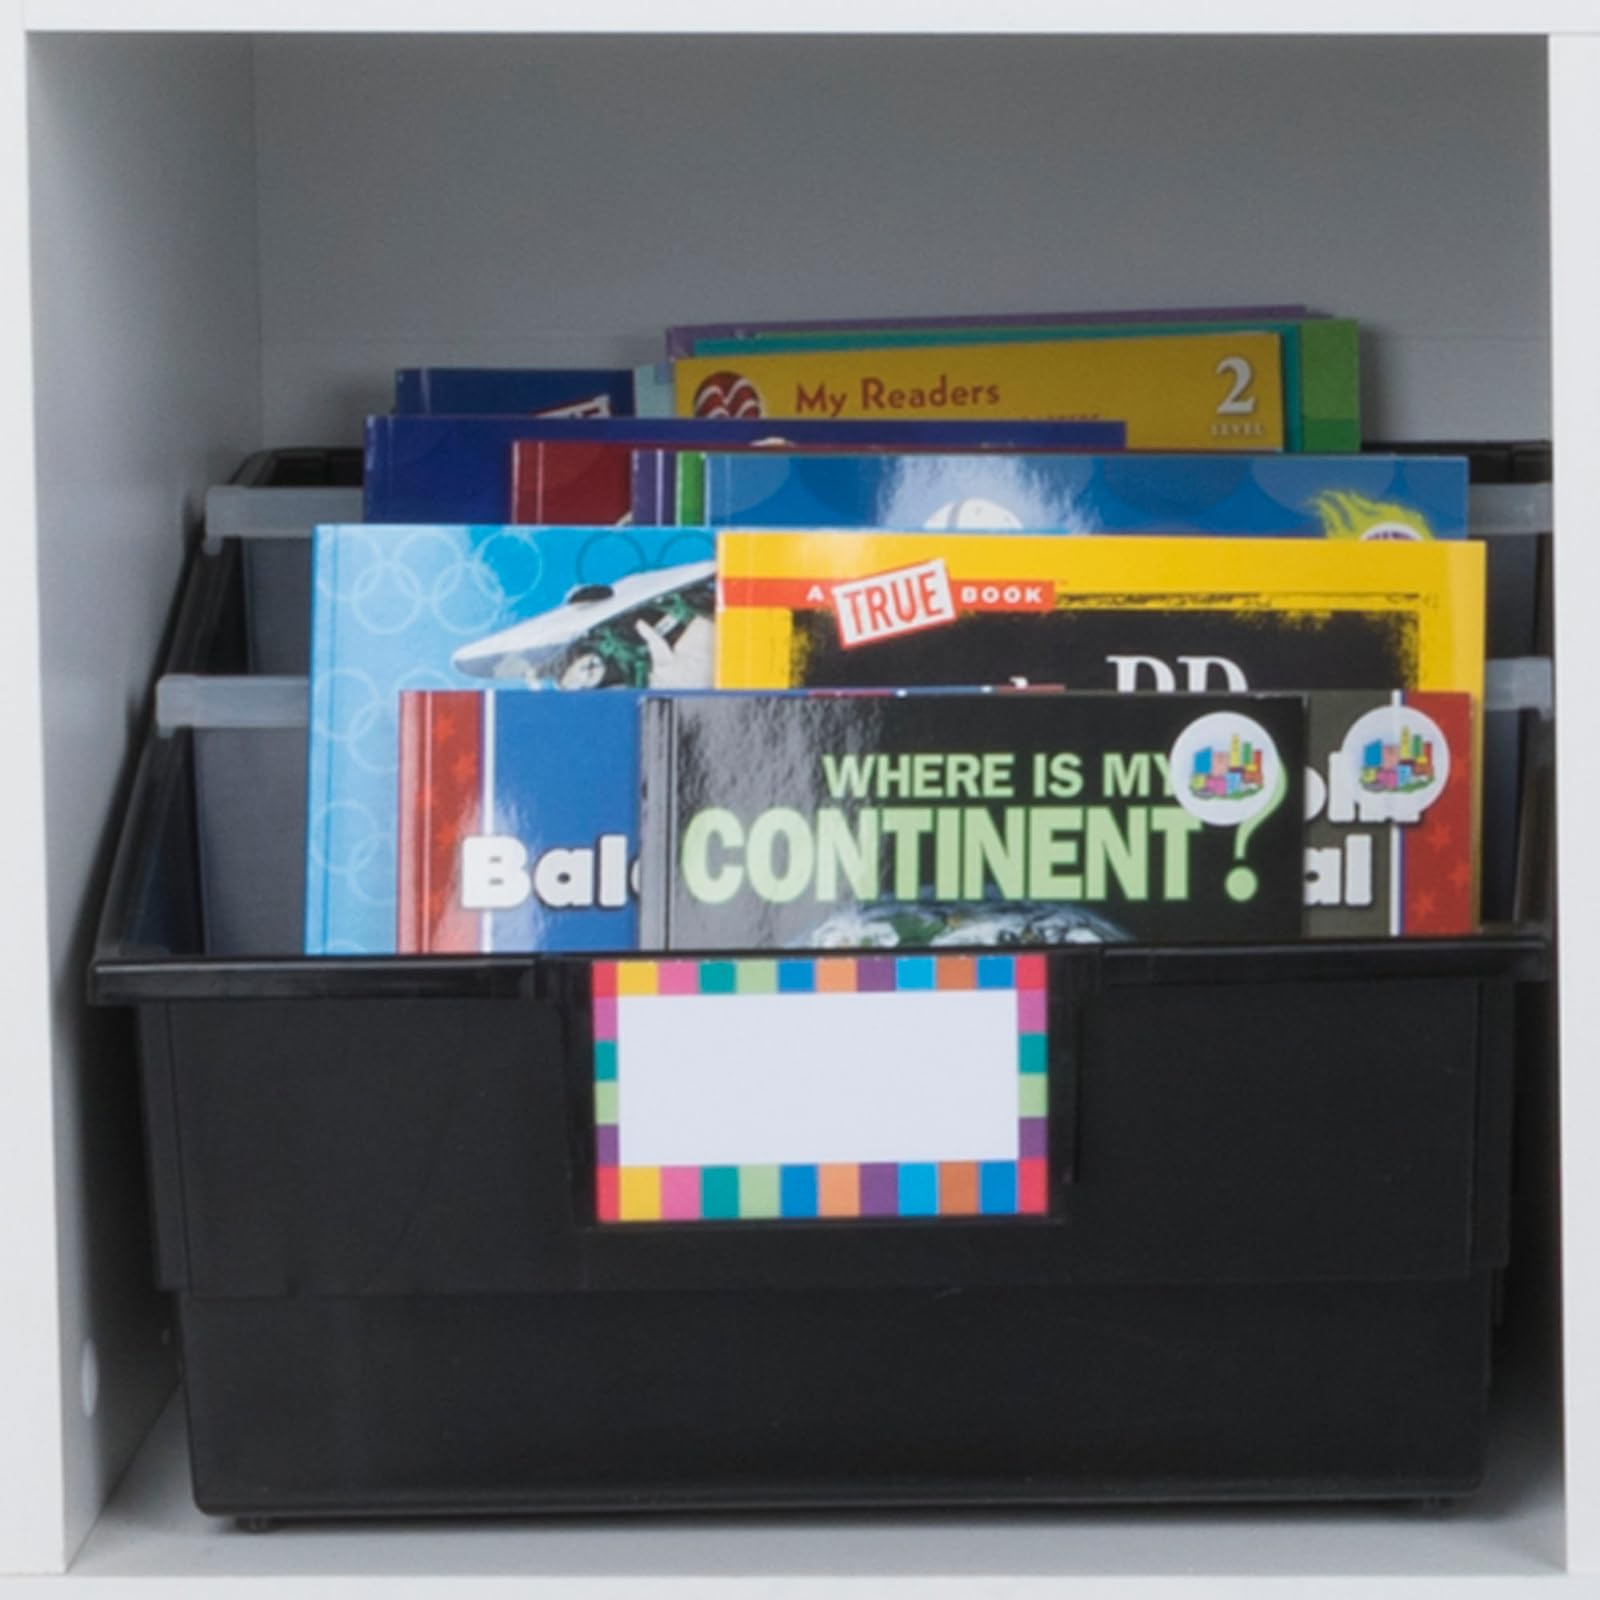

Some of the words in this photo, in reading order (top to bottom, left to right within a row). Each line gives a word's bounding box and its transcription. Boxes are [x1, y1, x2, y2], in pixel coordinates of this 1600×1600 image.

[795, 381, 847, 418] My
[860, 373, 1000, 411] Readers
[1215, 355, 1255, 415] 2
[806, 584, 826, 602] A
[842, 570, 945, 636] TRUE
[959, 584, 1044, 605] BOOK
[822, 752, 1016, 799] WHERE
[1033, 752, 1085, 799] IS
[460, 834, 640, 909] Bal
